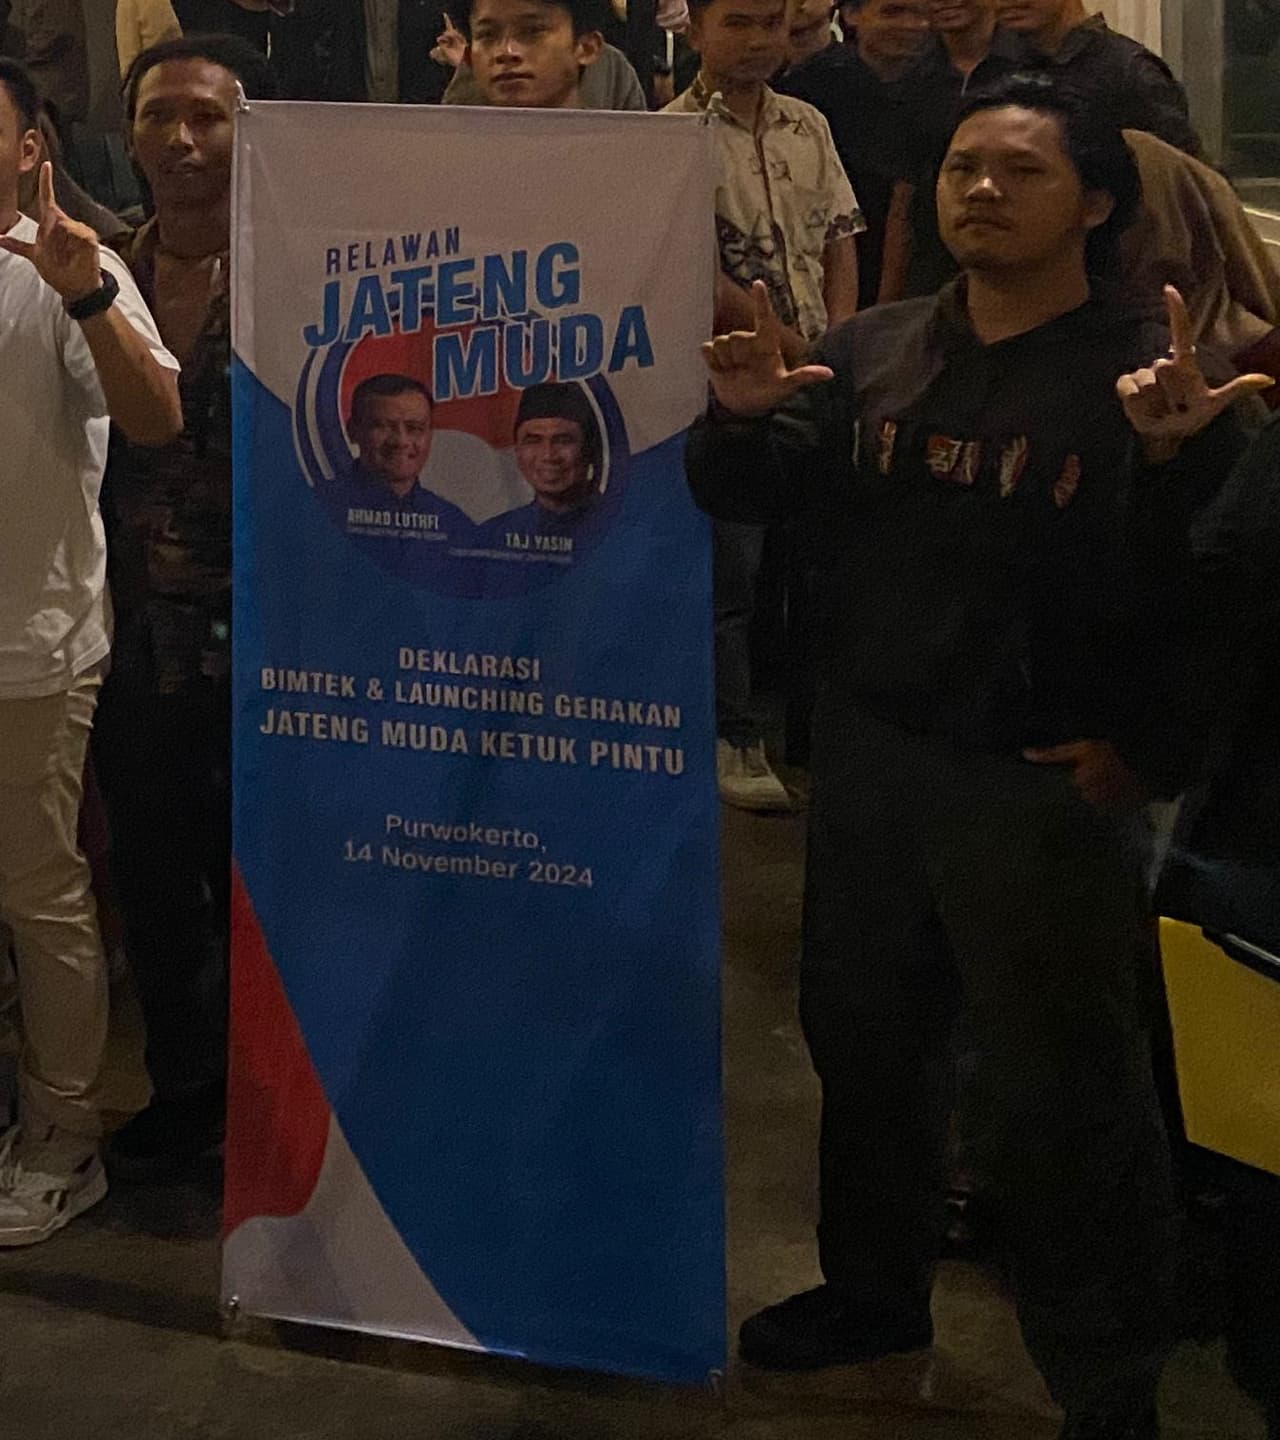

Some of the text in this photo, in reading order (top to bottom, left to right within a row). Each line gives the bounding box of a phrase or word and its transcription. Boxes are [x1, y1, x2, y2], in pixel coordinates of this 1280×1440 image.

[326, 226, 460, 275] RELAWAN
[304, 241, 581, 348] JATENG
[433, 305, 655, 402] MUDA
[347, 509, 439, 530] AHMAD LUTHFI
[505, 533, 573, 553] TAJ YASIN
[399, 647, 540, 681] DEKLARASI
[261, 667, 681, 728] BIMTEK & LAUNCHING GERAKAN
[260, 708, 685, 776] JATENG MUDA KETUK PINTU
[386, 815, 547, 853] Purwokerto,
[344, 840, 594, 888] 14 November 2024
